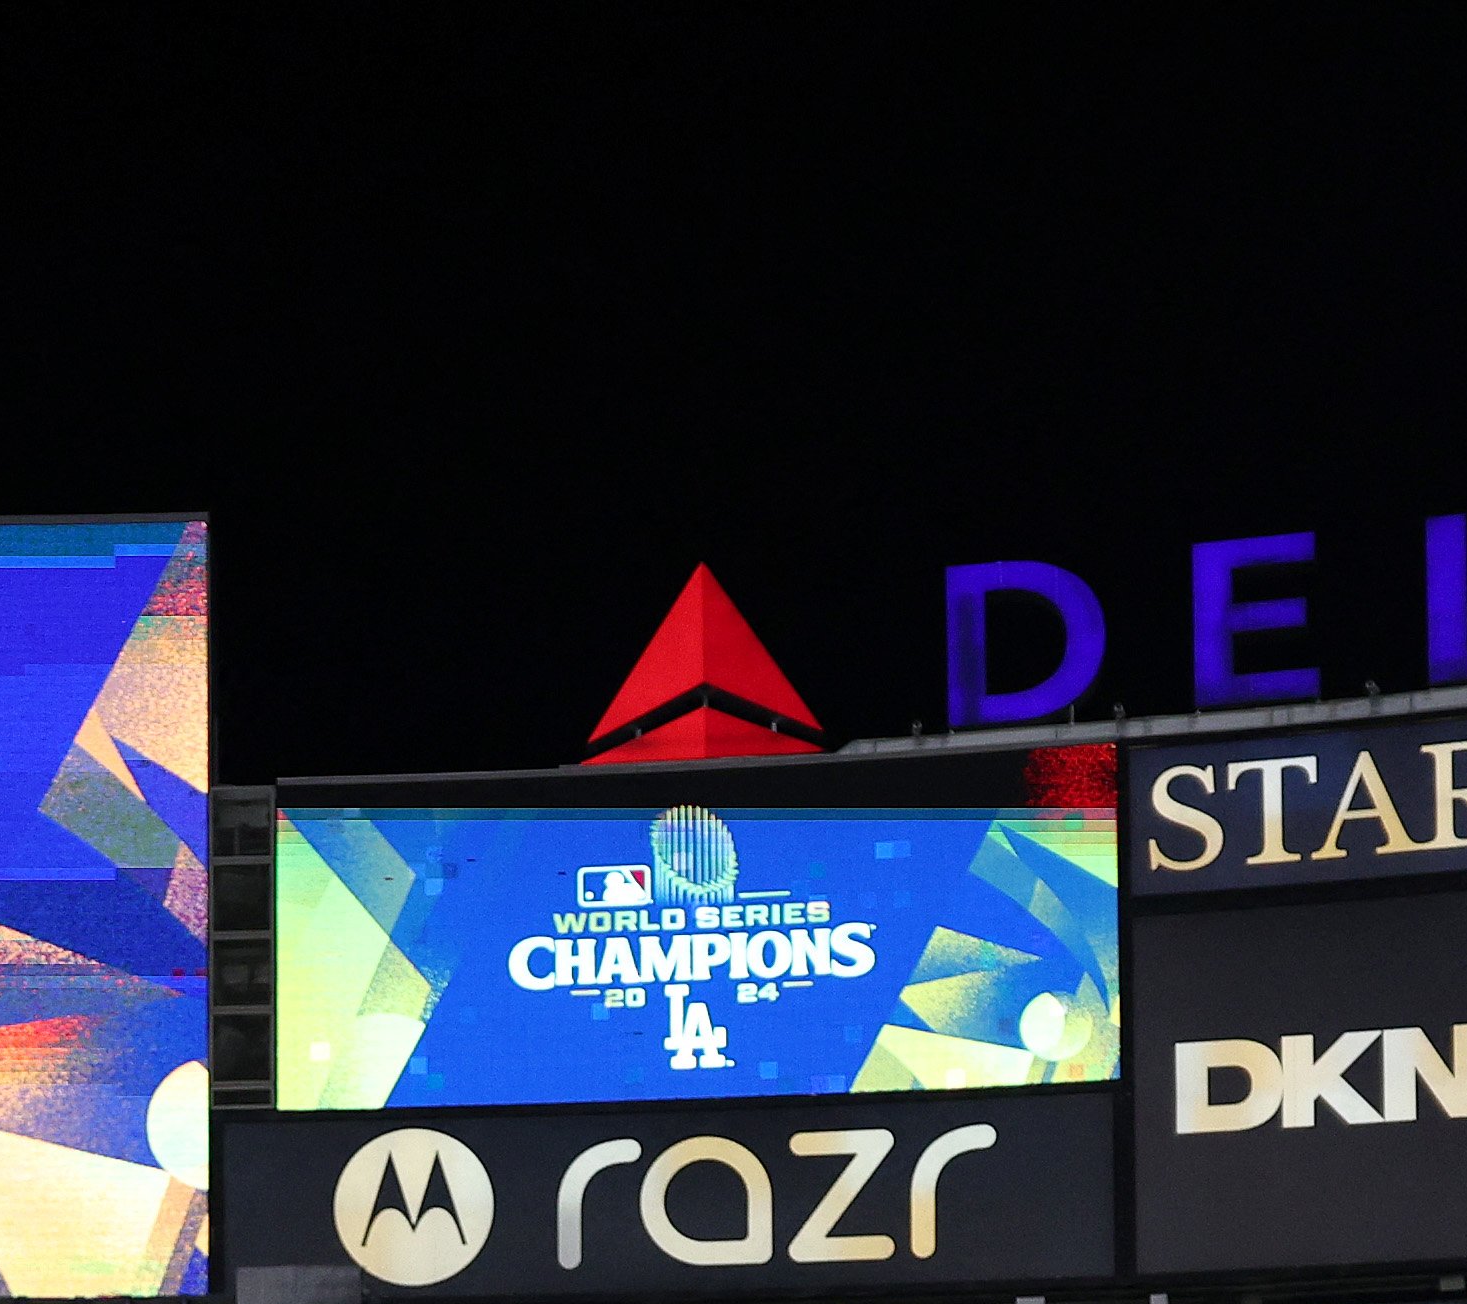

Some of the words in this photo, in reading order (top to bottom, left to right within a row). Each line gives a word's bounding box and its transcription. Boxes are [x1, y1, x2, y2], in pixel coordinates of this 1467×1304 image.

[552, 906, 688, 936] WORLD
[694, 900, 831, 929] SERIES
[507, 919, 874, 991] CHAMPIONS
[604, 987, 645, 1008] 20
[737, 982, 779, 1003] 24
[664, 984, 728, 1069] LA
[556, 1124, 998, 1270] razr
